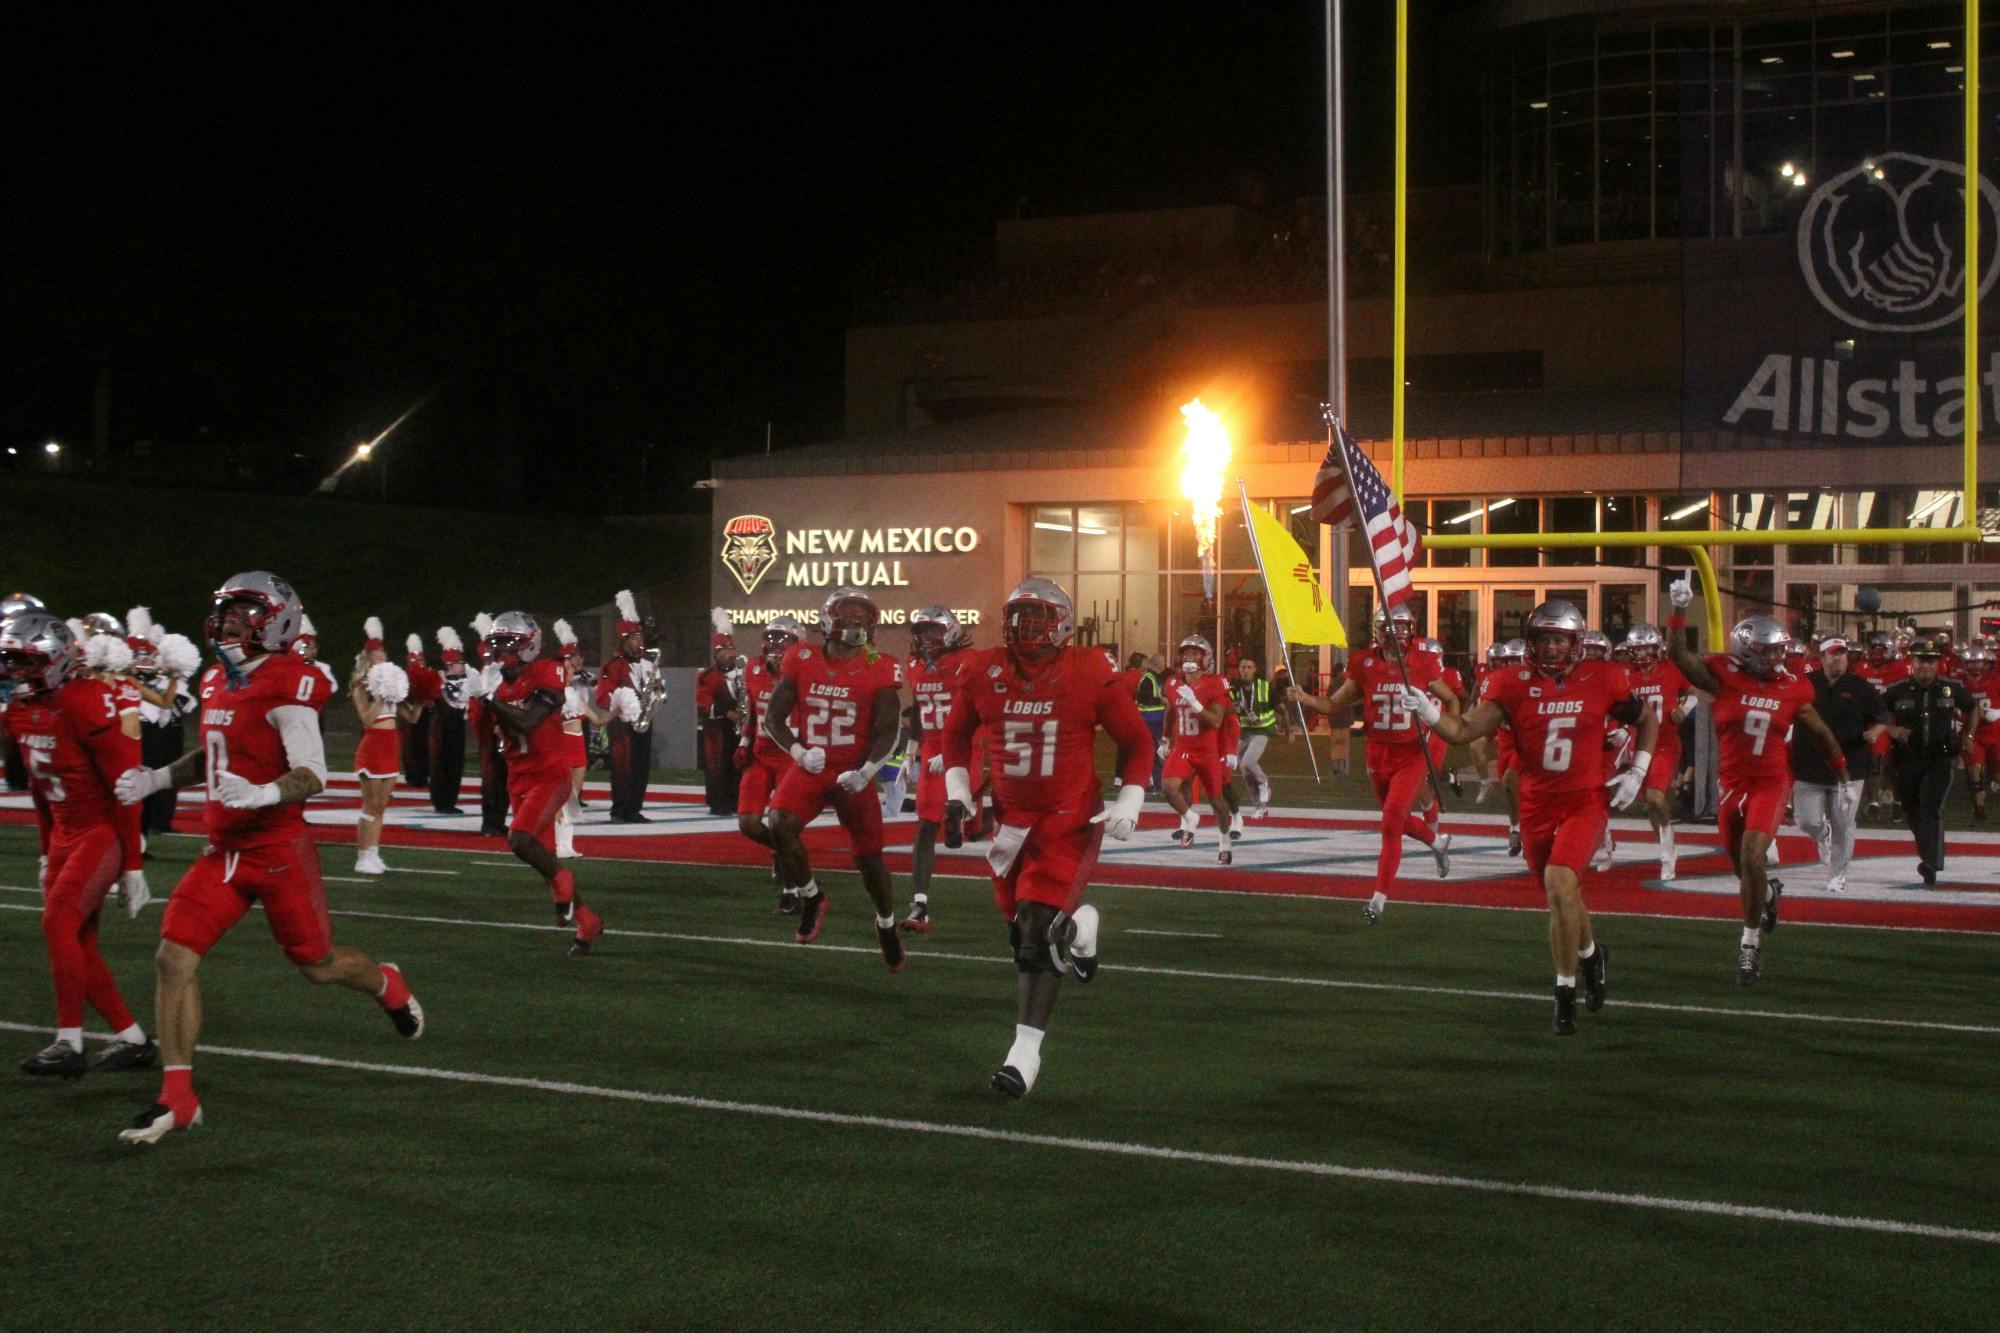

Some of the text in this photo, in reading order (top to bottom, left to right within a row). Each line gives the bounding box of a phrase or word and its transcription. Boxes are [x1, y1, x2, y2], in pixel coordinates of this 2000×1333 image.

[786, 527, 978, 554] NEW MEXICO
[785, 561, 909, 587] MUTUAL
[296, 674, 315, 702] 0
[809, 682, 850, 698] LOBOS
[916, 681, 944, 692] LOBOS
[1376, 682, 1403, 692] LOBO
[102, 693, 117, 718] 5
[1003, 699, 1054, 715] LOBOS
[1537, 700, 1585, 715] LOBOS
[1741, 694, 1781, 711] LOBOS
[806, 697, 857, 745] 22
[1176, 707, 1201, 736] 16
[1743, 709, 1772, 756] 9
[1003, 719, 1060, 778] 51
[1542, 717, 1577, 772] 6
[29, 748, 67, 803] 5
